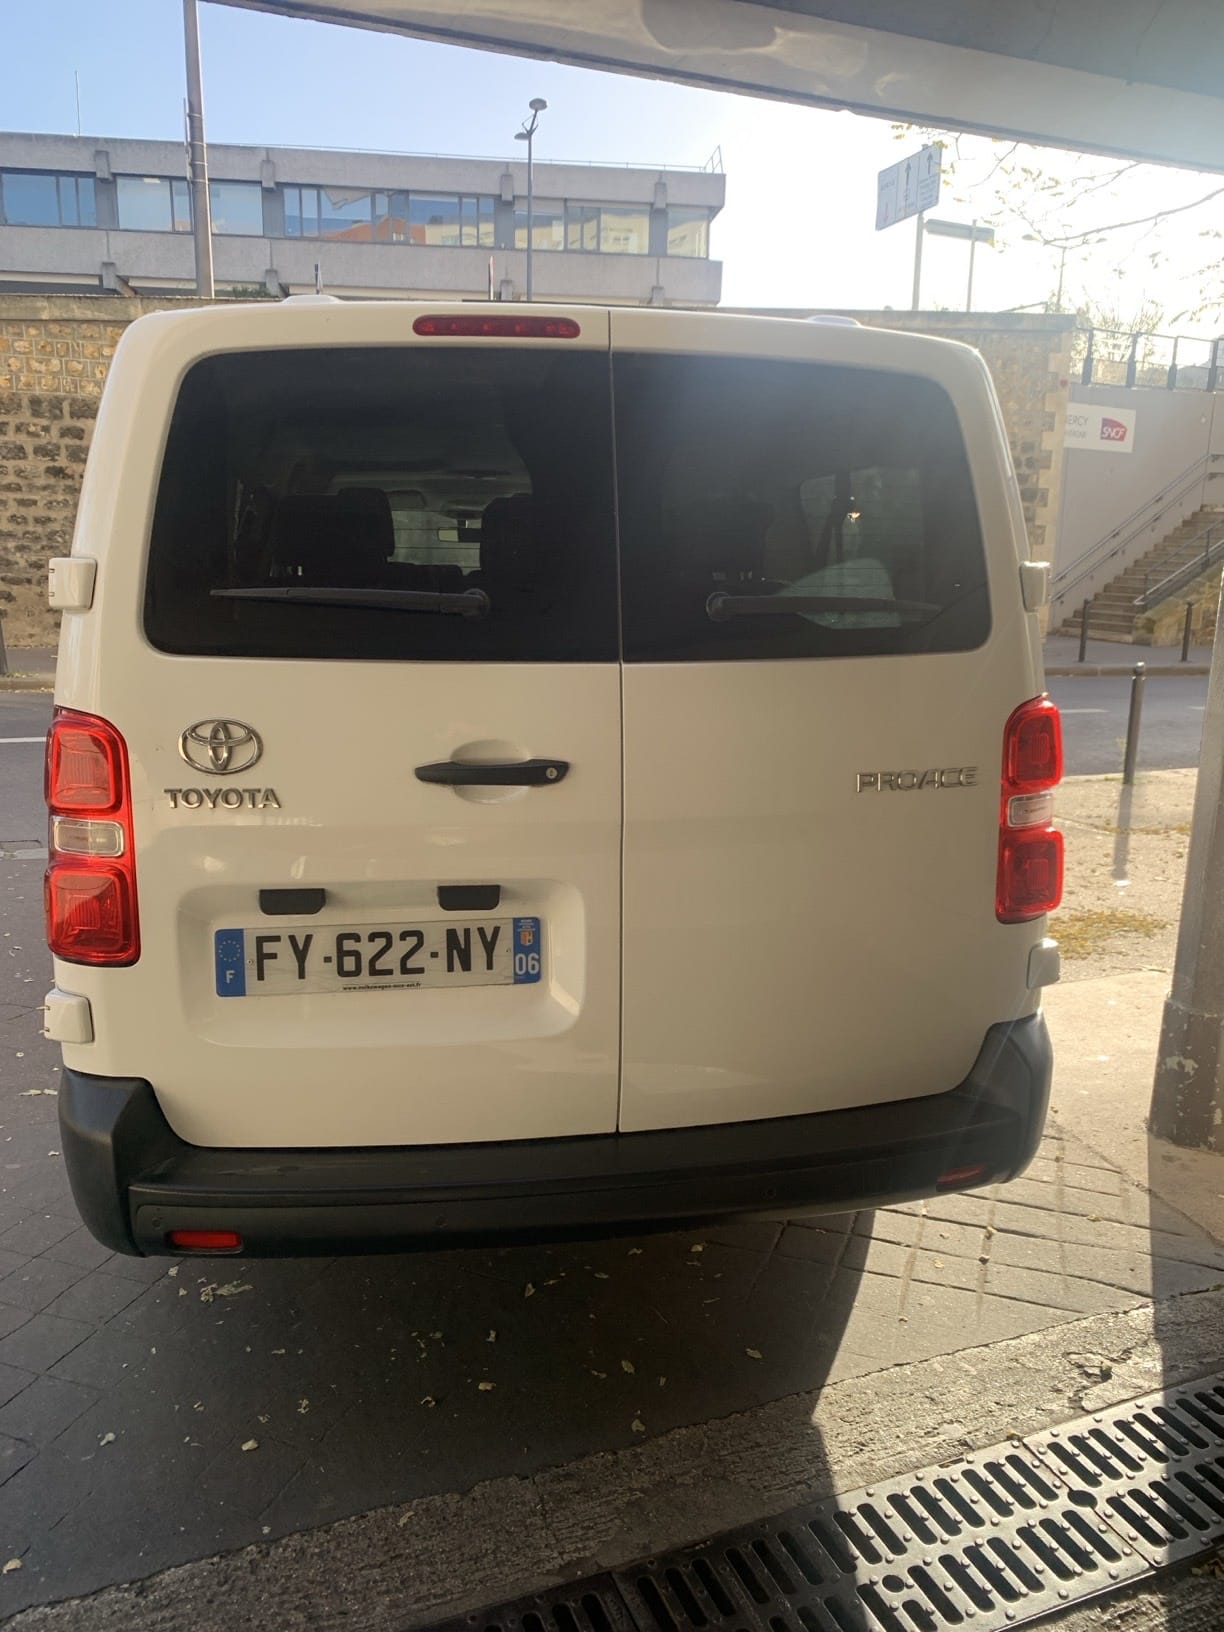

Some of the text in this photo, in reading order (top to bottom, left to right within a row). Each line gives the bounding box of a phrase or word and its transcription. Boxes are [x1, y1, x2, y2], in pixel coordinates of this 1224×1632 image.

[1101, 426, 1126, 439] SNCF
[855, 766, 978, 792] PROACE
[163, 788, 281, 809] TOYOTA
[255, 926, 501, 981] FY-622-NY
[514, 952, 540, 975] 06
[225, 970, 235, 984] F
